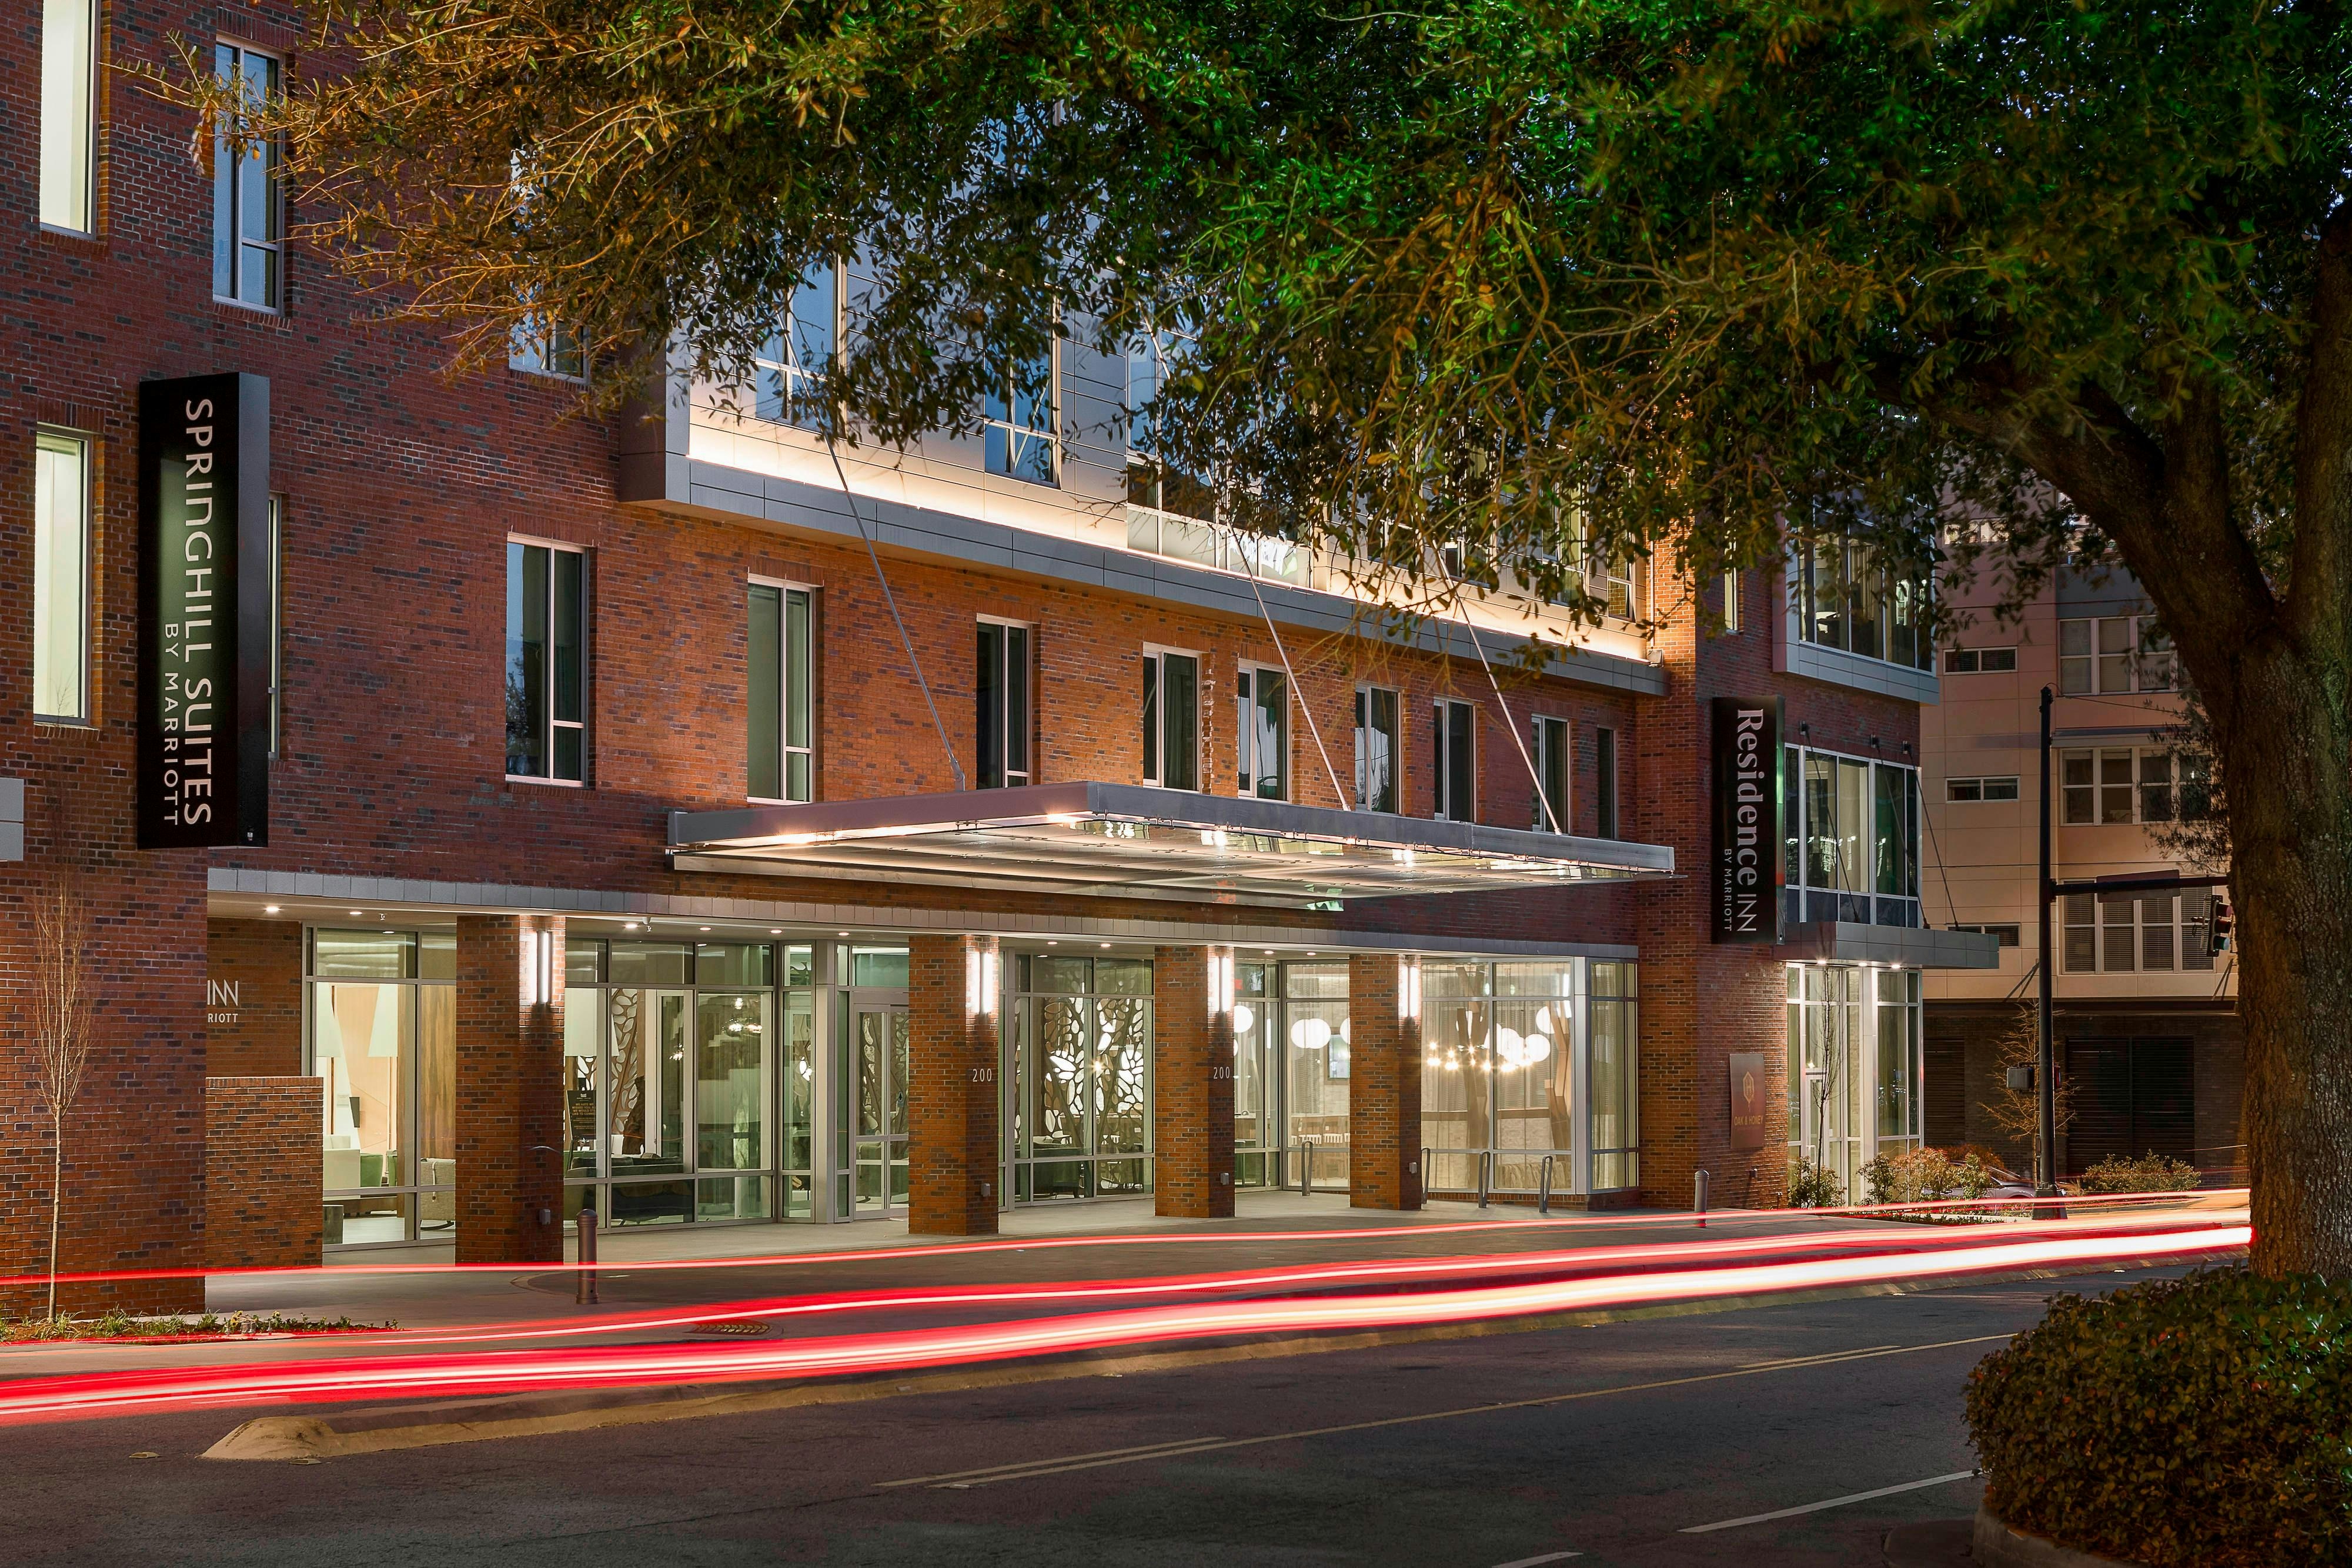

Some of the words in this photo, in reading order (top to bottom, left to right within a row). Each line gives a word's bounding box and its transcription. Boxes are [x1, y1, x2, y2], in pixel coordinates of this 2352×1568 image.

[185, 399, 212, 663] SPRINGHILL
[165, 623, 178, 657] BY
[164, 673, 178, 825] MARRIOTT
[184, 678, 212, 824] SUITES
[1736, 708, 1764, 885] Residence
[1723, 849, 1732, 863] BY
[1723, 869, 1732, 931] MARRIOTT
[1737, 894, 1757, 931] INN
[207, 979, 238, 1006] INN
[973, 1068, 992, 1082] 200
[1213, 1066, 1230, 1079] 200
